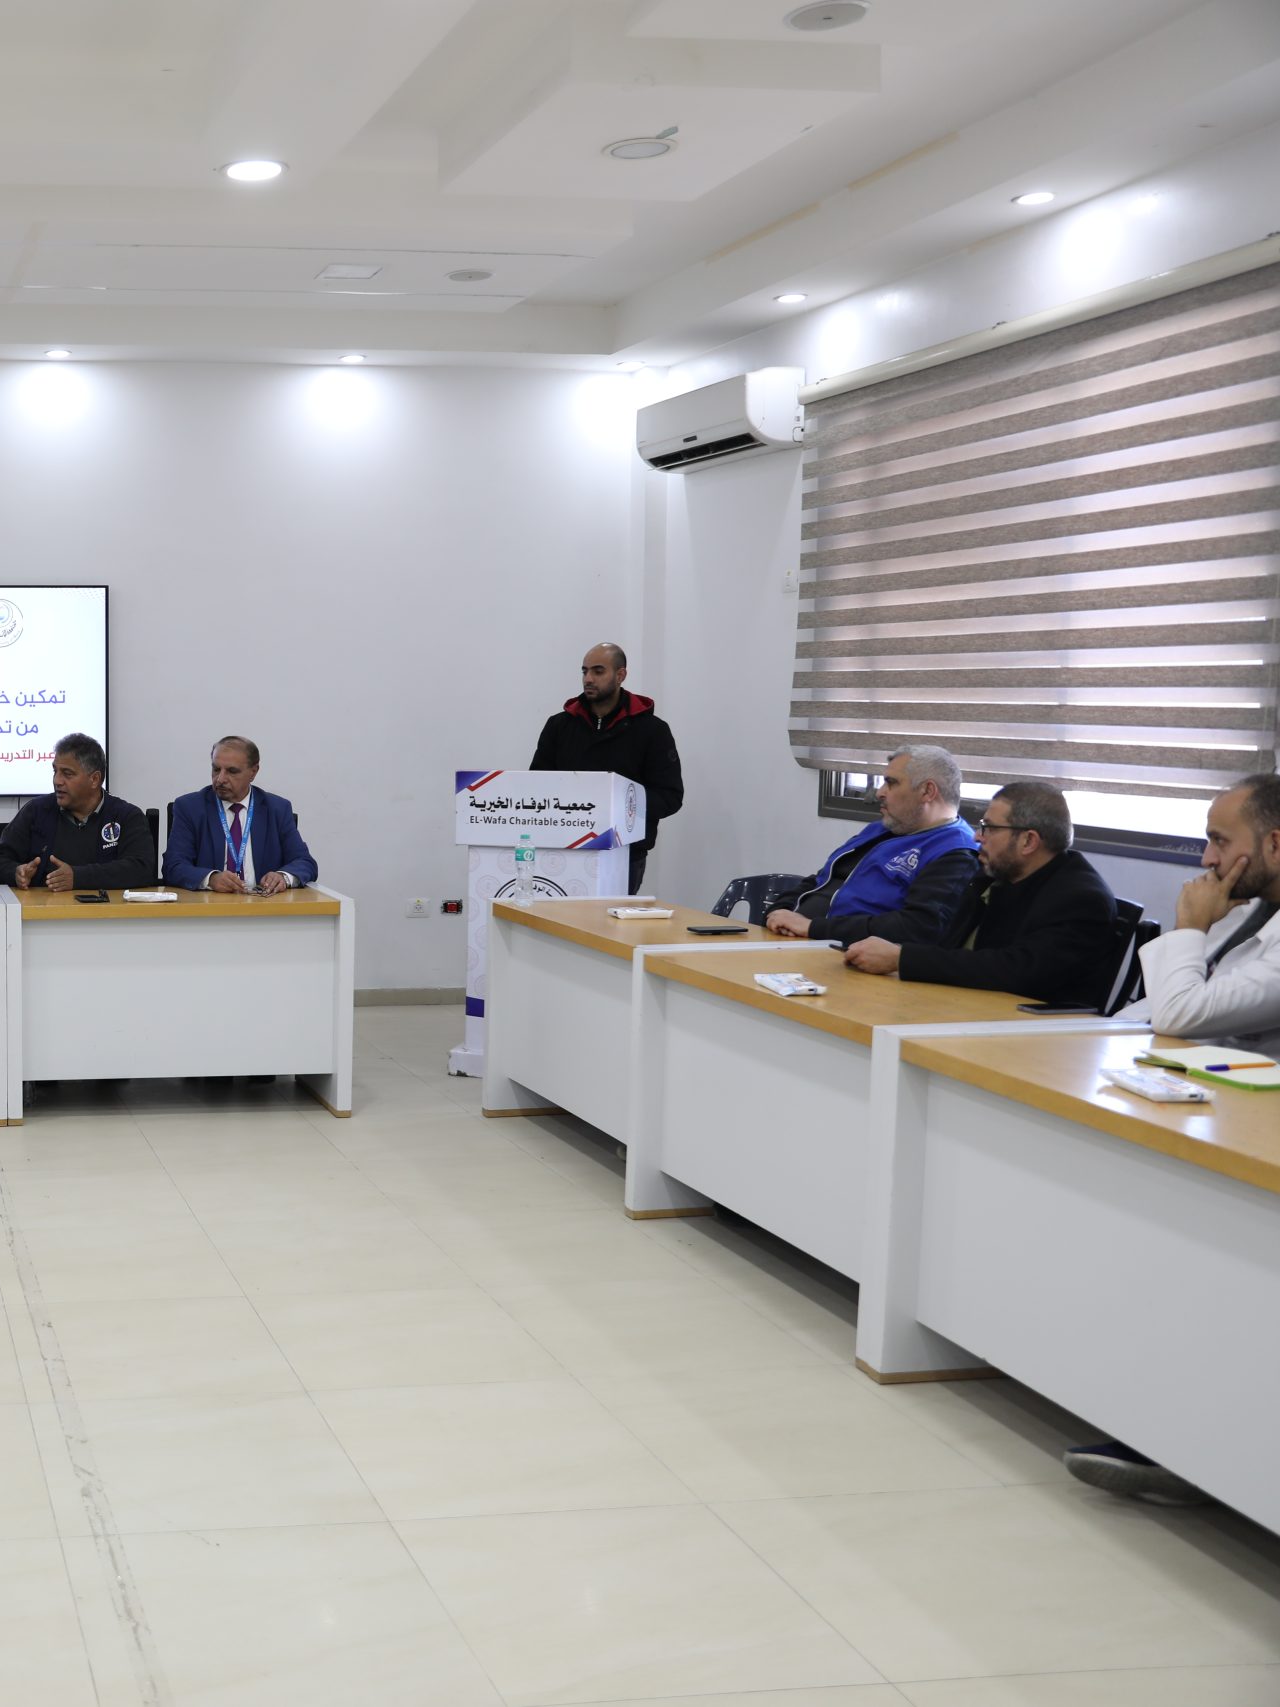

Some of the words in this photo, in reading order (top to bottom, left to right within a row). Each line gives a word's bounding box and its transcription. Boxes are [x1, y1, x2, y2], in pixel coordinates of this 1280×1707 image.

[15, 689, 66, 708] تمكين
[16, 721, 39, 736] من
[36, 750, 56, 763] عبر
[469, 795, 512, 812] الخيرية
[515, 798, 550, 813] الوفاء
[553, 798, 596, 815] جمعية
[470, 815, 507, 826] EL-Wafa
[509, 816, 558, 827] Charitable
[560, 818, 596, 829] Society
